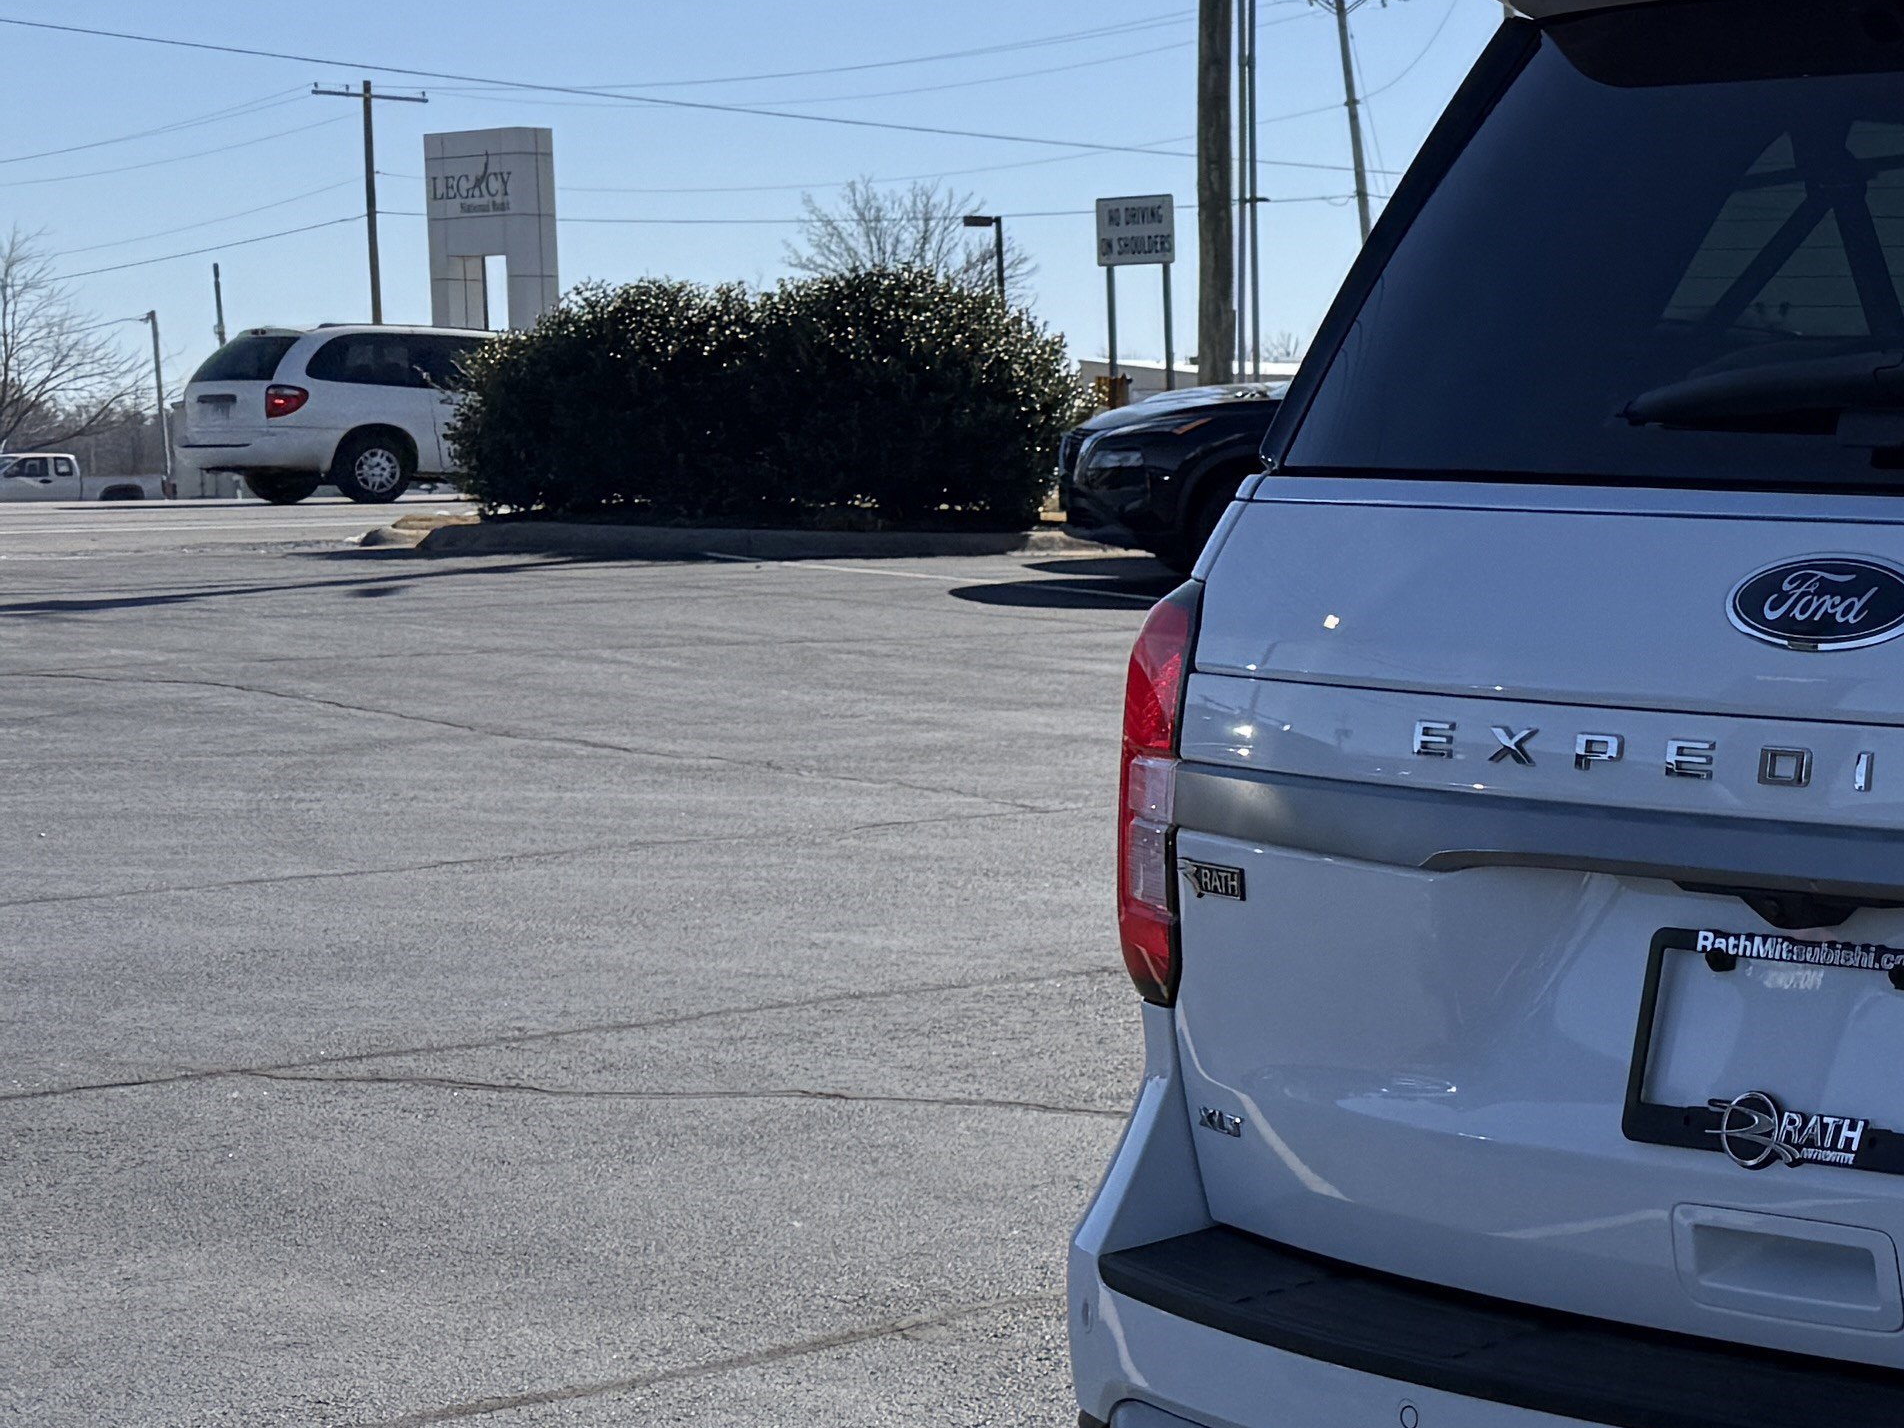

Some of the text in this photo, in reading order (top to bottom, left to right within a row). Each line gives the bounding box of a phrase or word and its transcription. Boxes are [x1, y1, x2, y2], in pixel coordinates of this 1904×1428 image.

[431, 171, 512, 201] LEGACY
[1107, 204, 1163, 227] NO DRIVING
[1100, 233, 1172, 257] ON SHOULDERS
[1762, 569, 1879, 624] Ford
[1200, 868, 1239, 896] RATH
[1199, 1105, 1244, 1139] XLT
[1778, 1111, 1865, 1152] RATH
